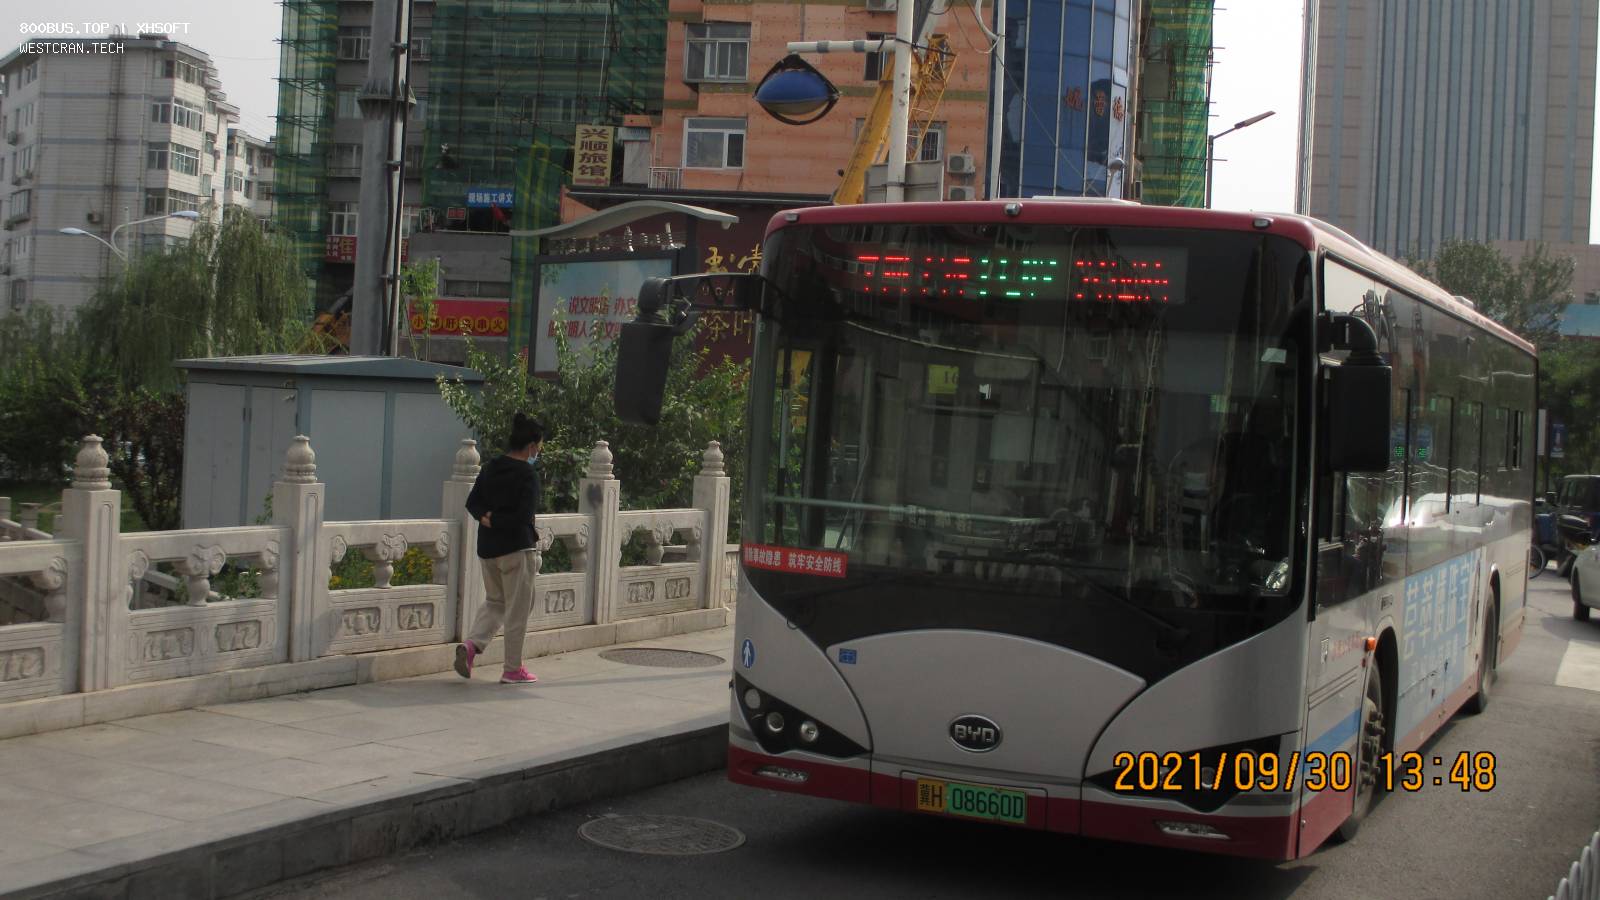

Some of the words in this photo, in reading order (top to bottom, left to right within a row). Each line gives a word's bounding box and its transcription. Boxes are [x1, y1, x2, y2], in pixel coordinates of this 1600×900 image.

[579, 128, 608, 176] 兴顺旅馆
[788, 552, 842, 573] 筑牢安全防线
[954, 723, 995, 743] BYD
[951, 787, 1025, 819] 08660D
